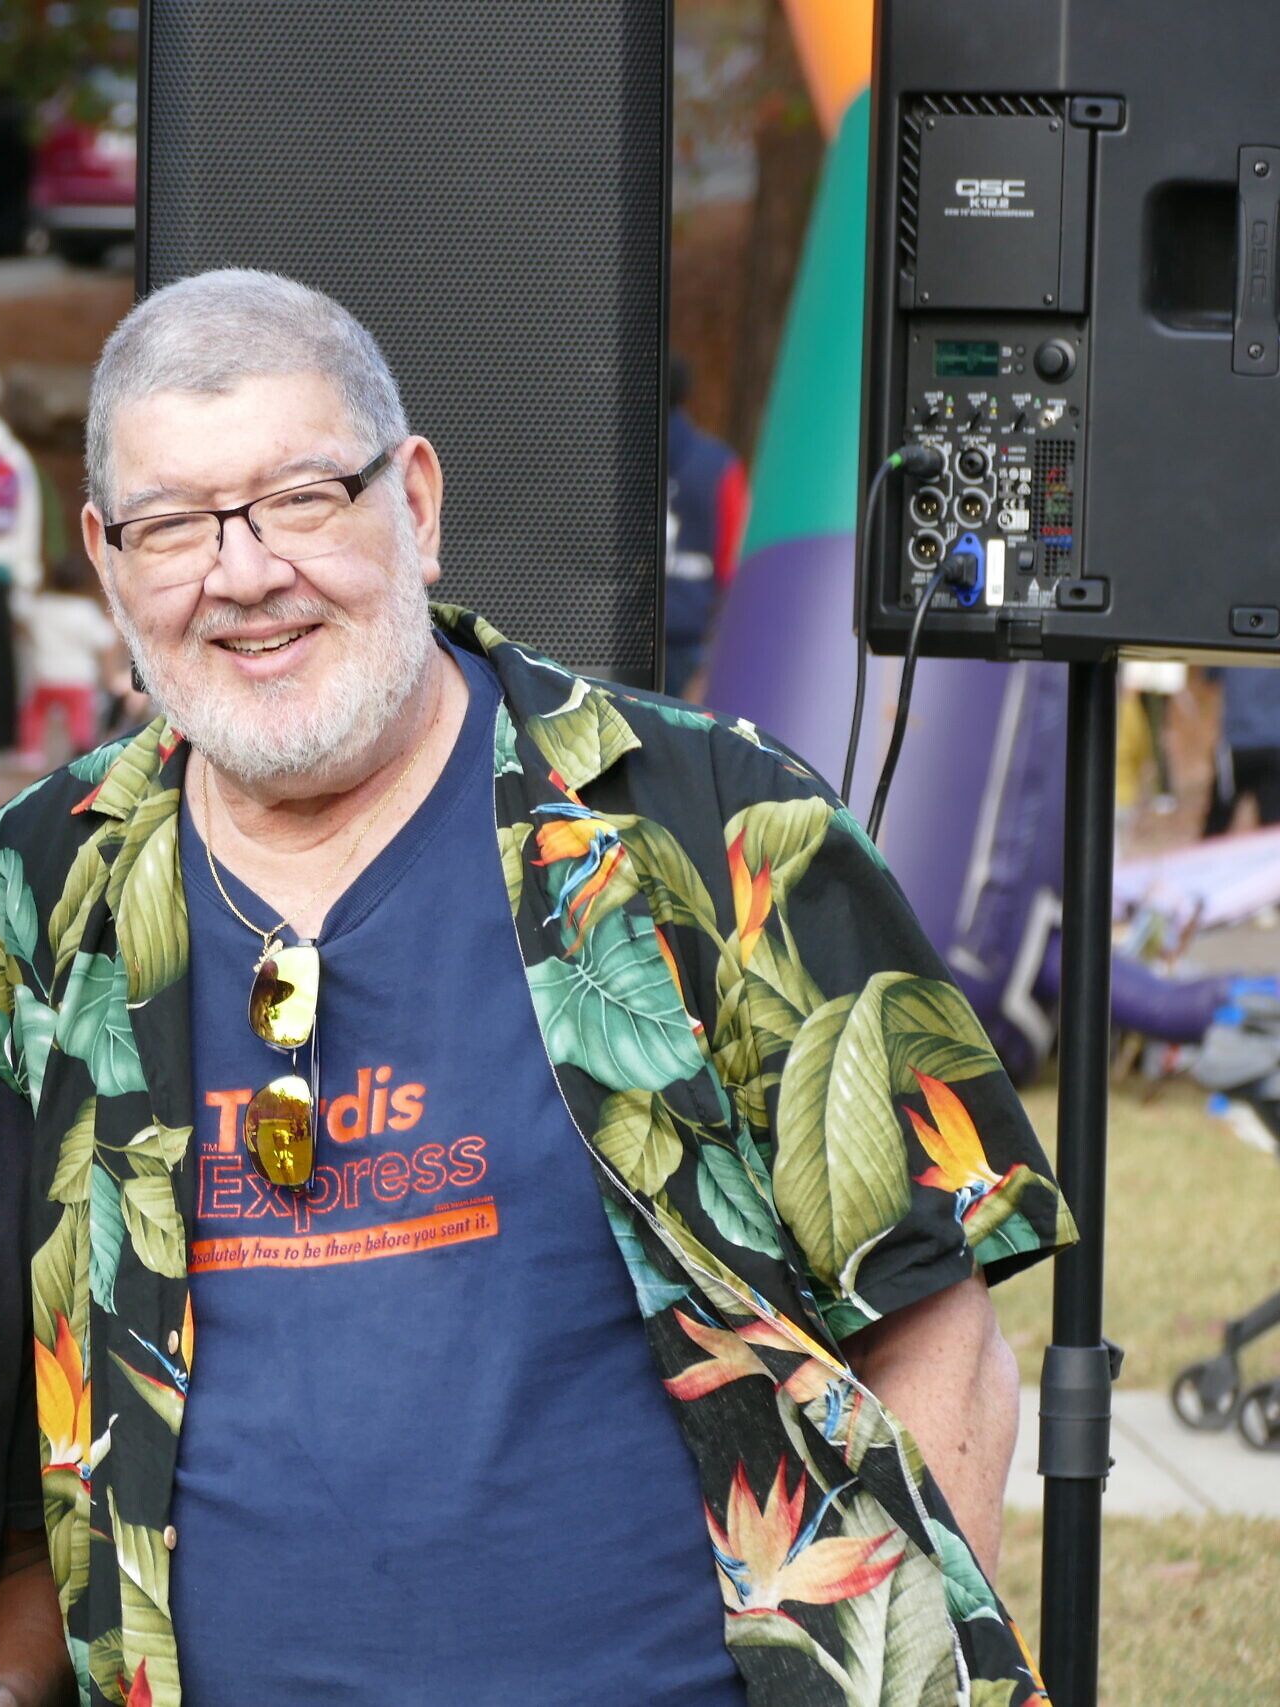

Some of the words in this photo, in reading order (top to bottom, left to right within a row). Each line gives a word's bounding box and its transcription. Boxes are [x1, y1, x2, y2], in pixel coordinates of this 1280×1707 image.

[955, 178, 1026, 198] QSC
[204, 1066, 426, 1153] Tdis
[198, 1136, 487, 1234] Express
[190, 1242, 250, 1265] bsolutely
[254, 1242, 279, 1260] has
[284, 1243, 299, 1261] to
[304, 1241, 321, 1259] be
[326, 1236, 362, 1257] there
[365, 1231, 410, 1252] before
[414, 1227, 437, 1247] you
[440, 1217, 471, 1237] sent
[475, 1212, 491, 1230] it.
